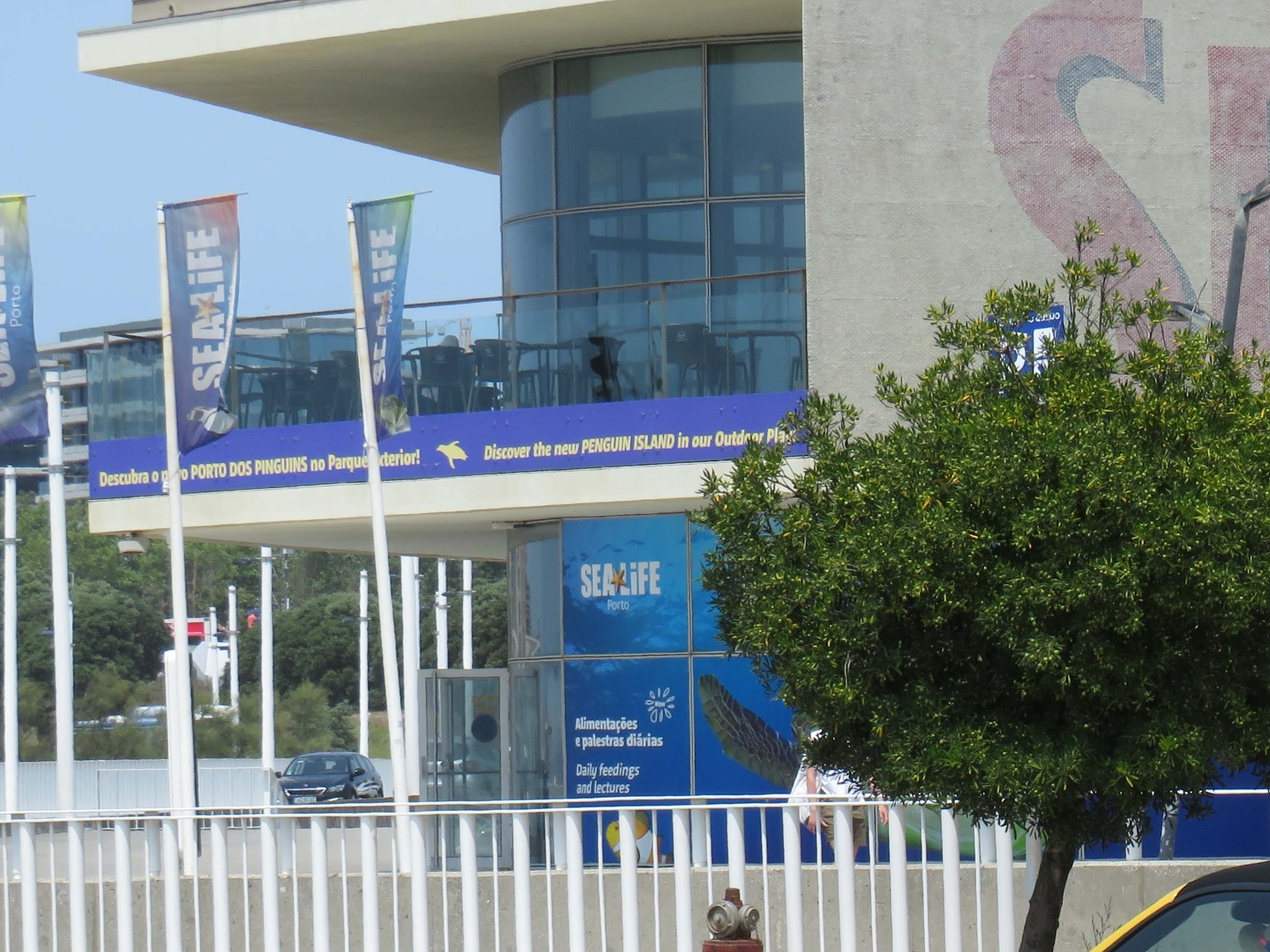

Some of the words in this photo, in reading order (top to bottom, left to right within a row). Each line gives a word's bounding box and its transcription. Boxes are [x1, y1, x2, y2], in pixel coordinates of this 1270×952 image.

[10, 285, 22, 327] Porto
[483, 443, 531, 461] Discover
[533, 441, 552, 457] the
[553, 442, 579, 456] new
[581, 435, 631, 454] PENGUIN
[633, 432, 675, 450] ISLAND
[677, 431, 689, 448] in
[691, 434, 712, 448] our
[714, 429, 764, 447] Outdoor
[99, 468, 149, 487] Descubra
[151, 472, 159, 482] o
[191, 462, 226, 480] PORTO
[229, 460, 253, 477] DOS
[254, 455, 308, 475] PINGUINS
[310, 458, 325, 472] no
[327, 453, 368, 473] Parque
[607, 599, 630, 611] Porto
[575, 717, 638, 734] Alimentações
[575, 736, 581, 747] e
[582, 733, 624, 751] palestras
[626, 733, 664, 747] diárias
[576, 763, 597, 779] Daily
[598, 762, 640, 780] feedings
[576, 780, 593, 794] and
[594, 780, 630, 794] lectures
